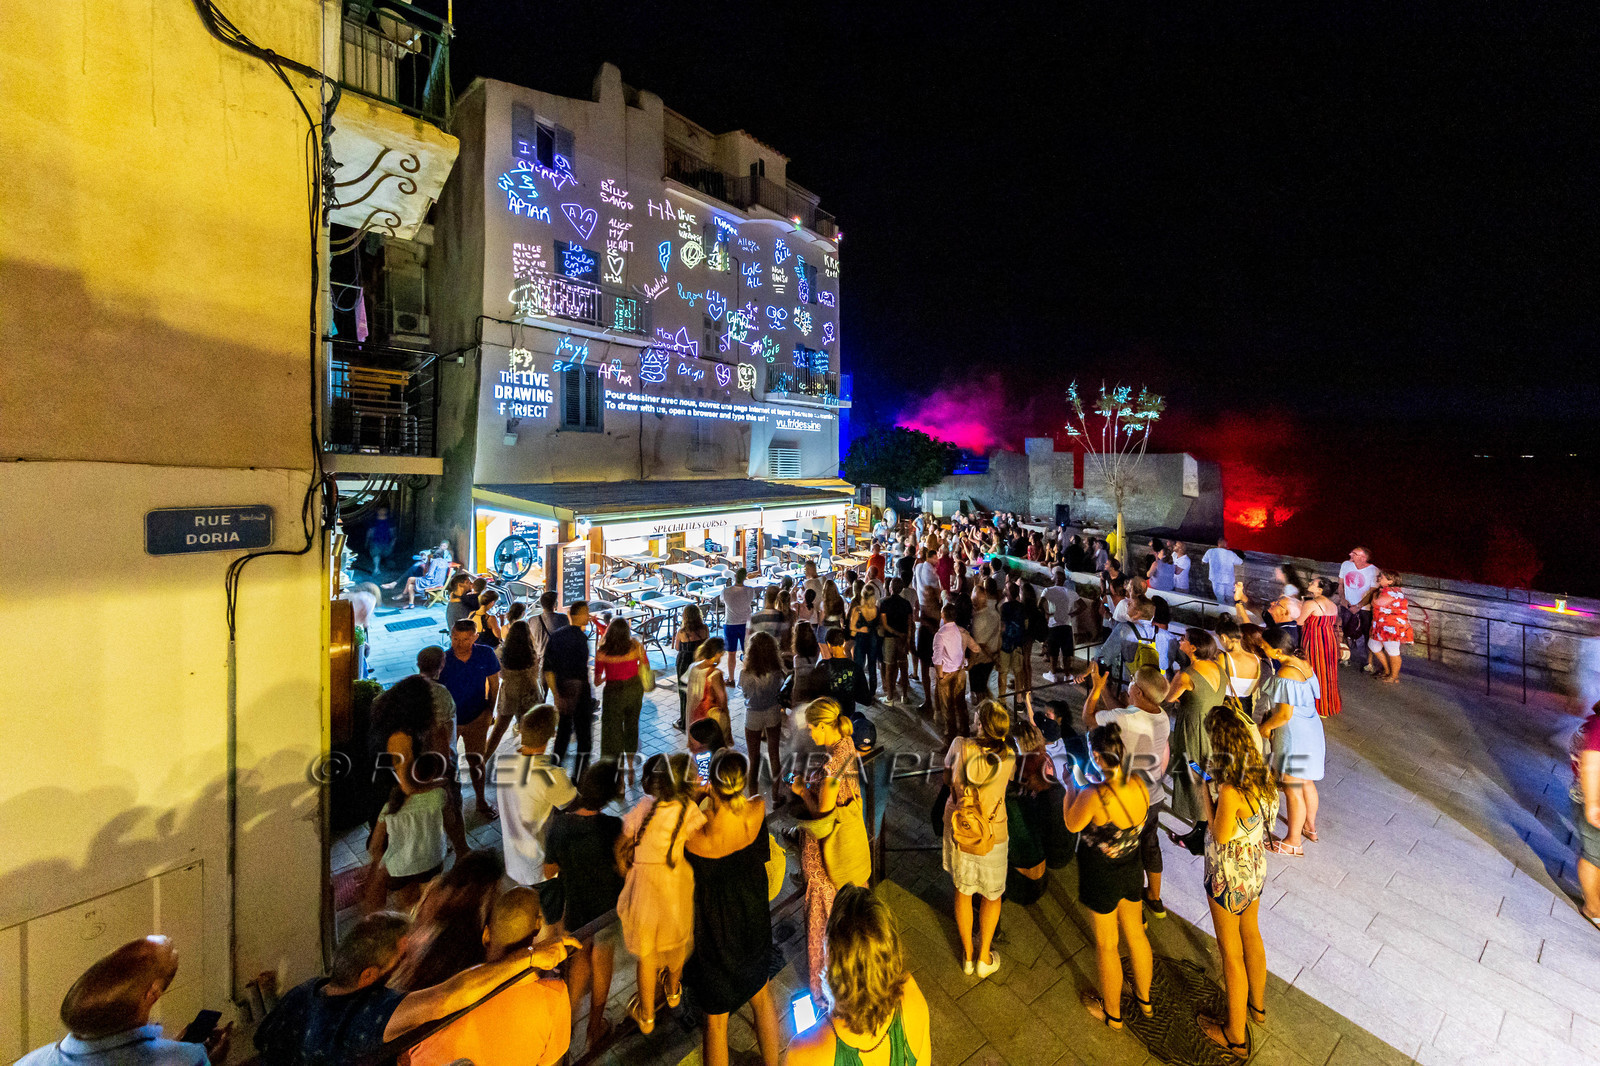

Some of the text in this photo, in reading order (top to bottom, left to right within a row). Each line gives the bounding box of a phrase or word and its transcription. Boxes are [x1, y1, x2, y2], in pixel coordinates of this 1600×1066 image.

[513, 243, 541, 253] ALICE
[500, 371, 550, 388] THE LIVE
[494, 384, 553, 403] DRAWING
[604, 389, 626, 400] Pour
[627, 393, 660, 403] dessiner
[679, 398, 698, 408] nous,
[733, 405, 748, 413] page
[604, 400, 616, 409] To
[617, 402, 638, 411] draw
[639, 404, 655, 413] with
[668, 408, 686, 416] open
[692, 409, 719, 418] browser
[731, 412, 745, 421] type
[194, 515, 231, 527] RUE
[186, 531, 240, 545] DORIA
